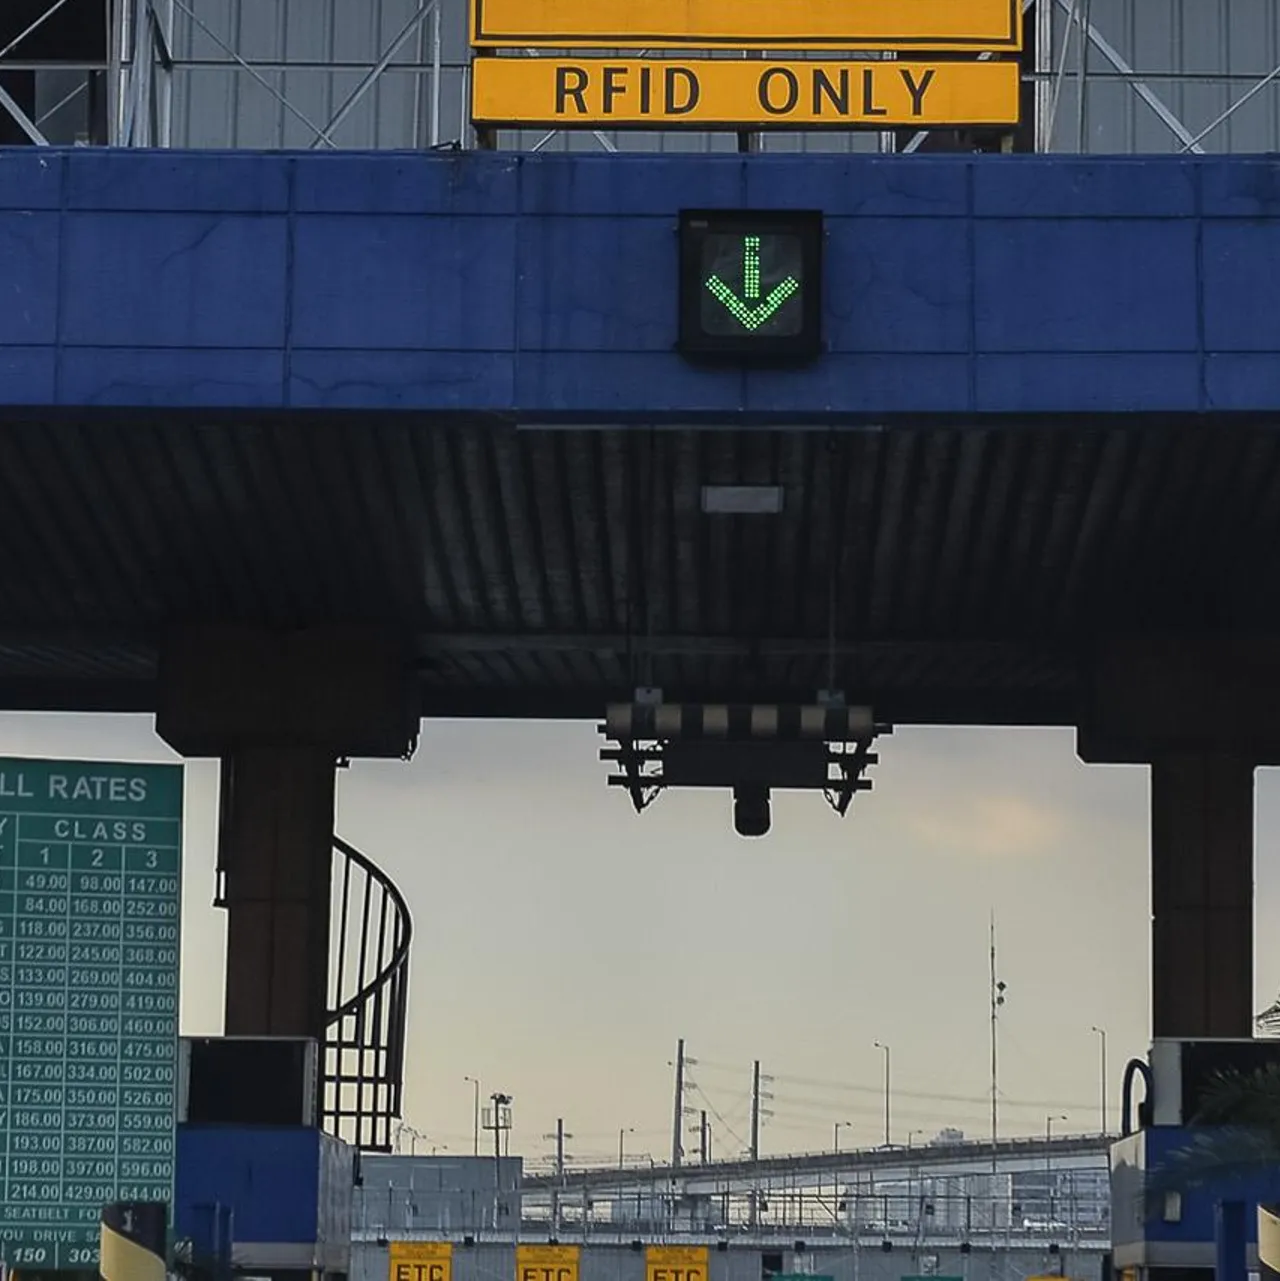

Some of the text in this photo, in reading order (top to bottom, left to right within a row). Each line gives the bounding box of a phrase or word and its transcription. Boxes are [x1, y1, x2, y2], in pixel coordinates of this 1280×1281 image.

[555, 67, 936, 116] RFID ONLY
[49, 775, 147, 801] RATES
[55, 820, 146, 841] CLASS
[41, 848, 157, 868] 1 2 3
[26, 874, 66, 889] 49.00
[80, 876, 120, 891] 98.00
[129, 878, 177, 892] 147.00
[26, 898, 66, 912] 84.00
[74, 900, 120, 914] 168.00
[128, 901, 176, 916] 252.00
[20, 922, 66, 936] 118.00
[73, 924, 120, 938] 237.00
[126, 925, 175, 939] 356.00
[19, 945, 65, 959] 122.00
[72, 947, 119, 961] 245.00
[126, 949, 175, 962] 368.00
[18, 969, 65, 983] 133.00
[72, 970, 118, 984] 269.00
[126, 972, 175, 985] 404.00
[18, 992, 64, 1006] 139.00
[71, 994, 118, 1008] 279.00
[126, 995, 174, 1009] 419.00
[18, 1016, 63, 1030] 152.00
[125, 1019, 174, 1033] 460.00
[17, 1040, 63, 1054] 158.00
[125, 1044, 174, 1057] 475.00
[16, 1065, 62, 1079] 167.00
[68, 1066, 116, 1080] 334.00
[124, 1067, 173, 1081] 502.00
[16, 1089, 61, 1103] 175.00
[68, 1090, 115, 1104] 350.00
[124, 1092, 173, 1105] 526.00
[14, 1113, 61, 1127] 186.00
[69, 1114, 114, 1128] 373.00
[124, 1116, 172, 1129] 559.00
[13, 1137, 60, 1150] 193.00
[68, 1138, 114, 1151] 387.00
[123, 1139, 171, 1152] 582.00
[12, 1161, 59, 1175] 198.00
[68, 1162, 114, 1175] 397.00
[122, 1164, 171, 1176] 596.00
[11, 1185, 59, 1199] 214.00
[66, 1186, 113, 1199] 429.00
[121, 1187, 170, 1200] 644.00
[5, 1208, 69, 1220] SEATBELT
[34, 1230, 76, 1241] DRIVE
[13, 1248, 46, 1262] 150
[397, 1265, 443, 1281] ETC
